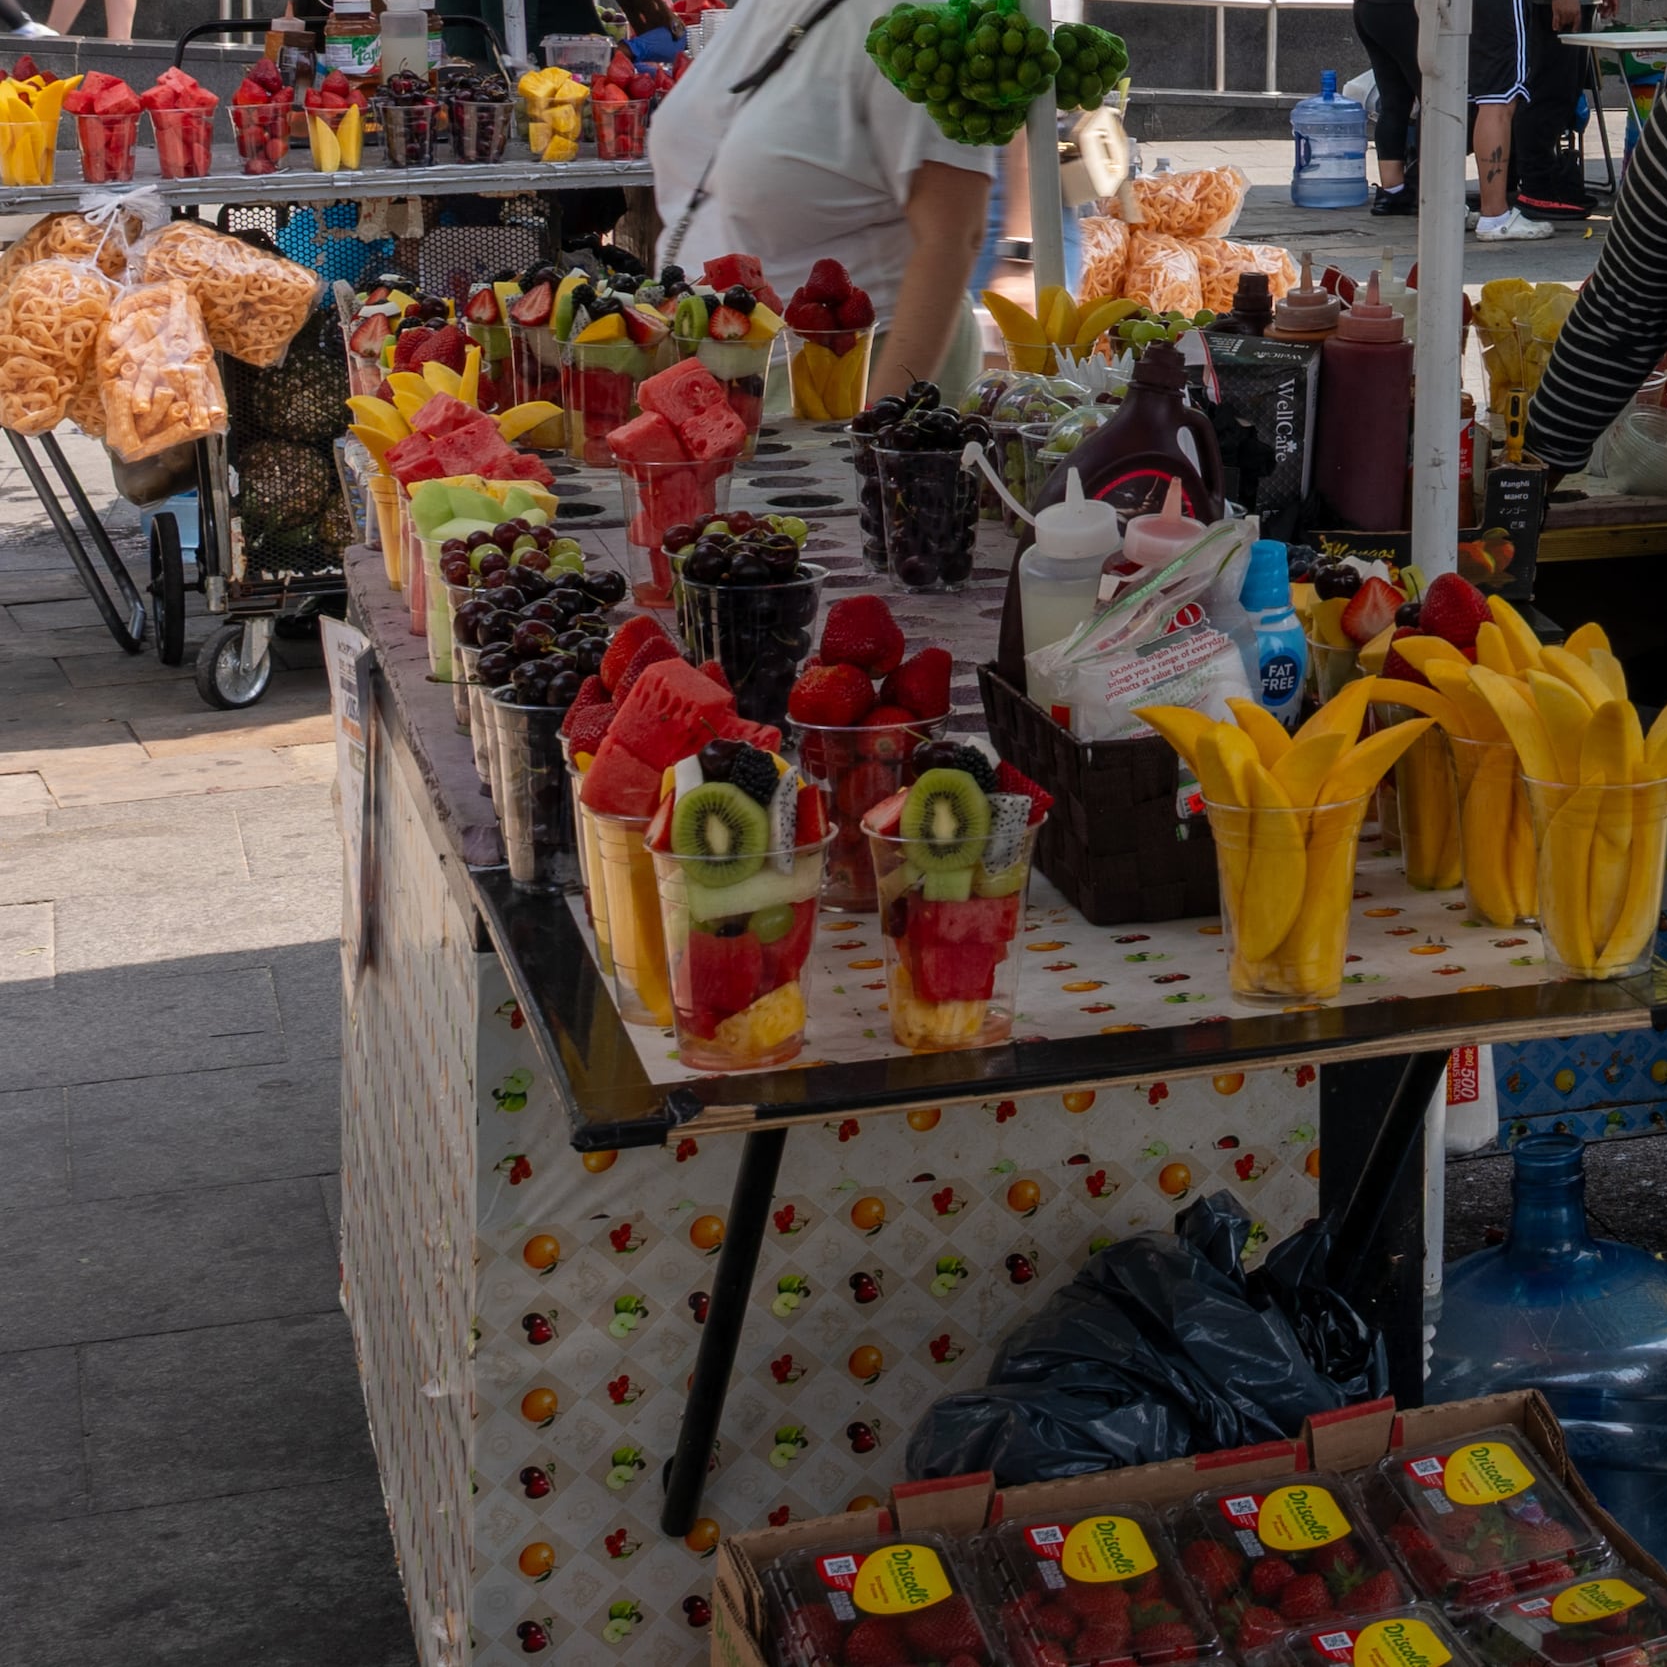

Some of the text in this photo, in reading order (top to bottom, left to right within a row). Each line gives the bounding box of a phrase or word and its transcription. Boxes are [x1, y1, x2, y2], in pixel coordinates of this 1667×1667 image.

[1275, 378, 1296, 462] WellCare
[1108, 675, 1133, 689] brings
[1135, 668, 1150, 679] you
[1158, 656, 1179, 669] range
[1181, 649, 1190, 658] of
[1191, 636, 1226, 654] everyday
[1146, 649, 1169, 663] origin
[1170, 641, 1190, 652] from
[1268, 663, 1293, 678] FAT
[1104, 682, 1140, 702] products
[1142, 677, 1150, 686] at
[1151, 669, 1172, 682] value
[1173, 661, 1184, 672] for
[1261, 676, 1294, 691] FREE
[1469, 1446, 1514, 1495] Driscoll's
[1288, 1489, 1331, 1541] Driscoll's
[1095, 1521, 1136, 1575] Driscoll's
[891, 1549, 926, 1605] Driscoll's
